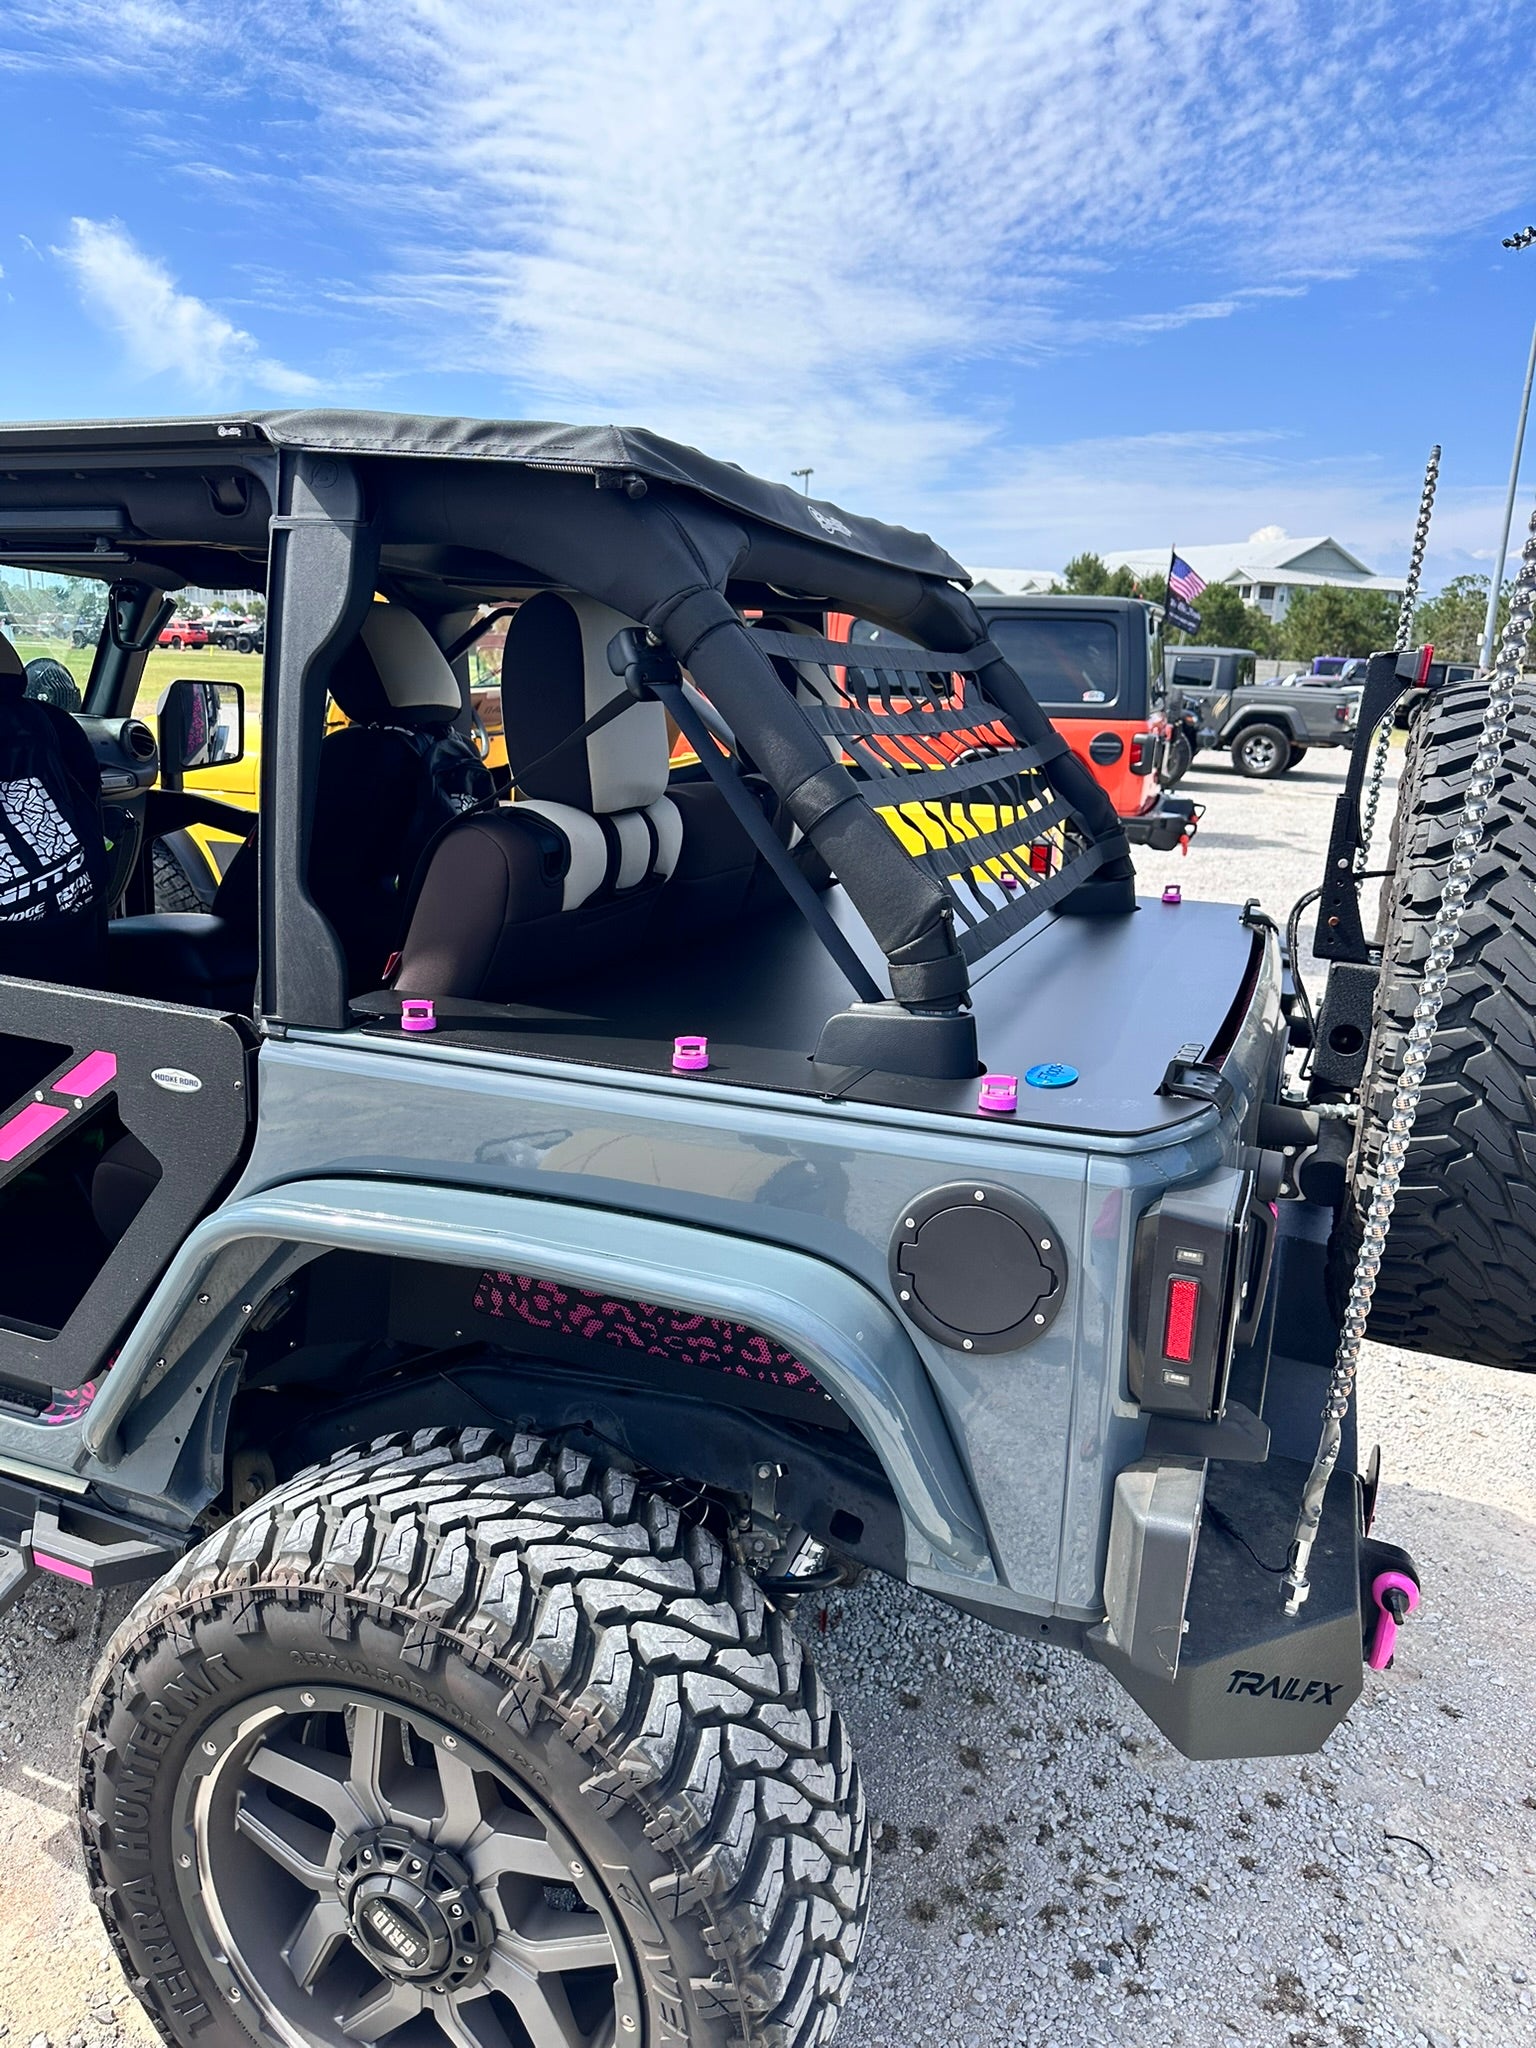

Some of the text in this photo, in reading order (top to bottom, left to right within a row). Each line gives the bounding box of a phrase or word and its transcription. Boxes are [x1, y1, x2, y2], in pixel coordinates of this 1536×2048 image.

[154, 1072, 199, 1088] HOOKE ROAD
[1225, 1669, 1344, 1706] TRAILFX
[114, 1652, 242, 2041] TERRA HUNTER M/T
[372, 1910, 417, 1958] GRID
